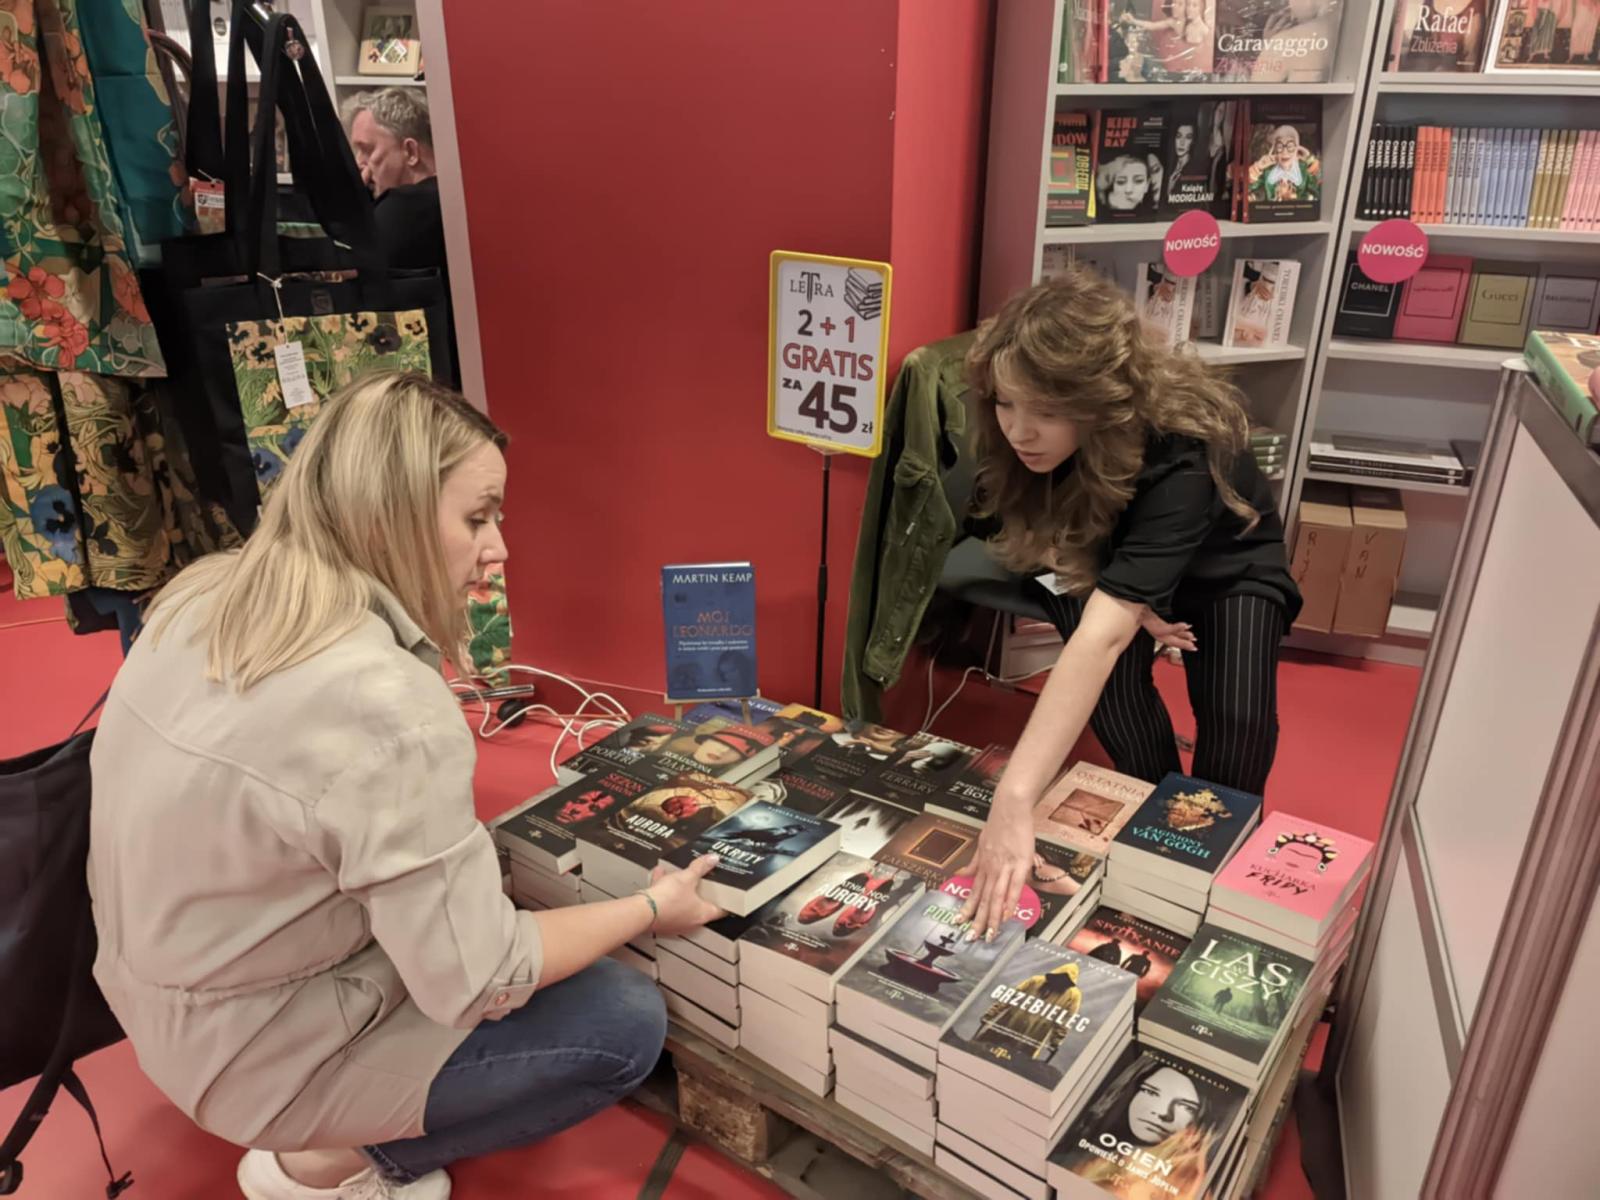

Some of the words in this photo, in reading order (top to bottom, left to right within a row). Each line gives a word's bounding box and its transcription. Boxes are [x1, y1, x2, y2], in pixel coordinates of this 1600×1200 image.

[1416, 4, 1476, 35] Rafael
[1217, 33, 1329, 58] Caravaggio
[1166, 232, 1219, 252] NOWOŚĆ
[1361, 242, 1425, 258] NOWOŚĆ
[790, 271, 834, 304] LETRA
[1351, 281, 1390, 293] CHANEL
[798, 308, 813, 337] 2
[843, 315, 856, 343] 1
[782, 342, 874, 382] GRATIS
[782, 377, 802, 392] ZA
[798, 381, 858, 434] 45
[672, 573, 719, 584] MARTIN
[721, 572, 752, 583] KEMP
[697, 608, 730, 624] MÓJ
[672, 623, 753, 638] LEONARDO
[1076, 771, 1145, 798] OSTATNIA
[625, 814, 676, 839] AURORA
[1144, 825, 1204, 848] ZAGINIONY
[711, 841, 766, 865] UKRYTY
[1132, 826, 1162, 845] VAN
[1163, 839, 1211, 859] GOGH
[817, 883, 880, 911] AURORY
[867, 890, 890, 902] NOC
[1094, 919, 1181, 957] SPOTKANIE
[1200, 938, 1293, 987] LAS
[1190, 959, 1281, 1000] CISZY
[990, 983, 1091, 1034] GRZEBIELEC
[1099, 1132, 1174, 1177] OGIEŃ
